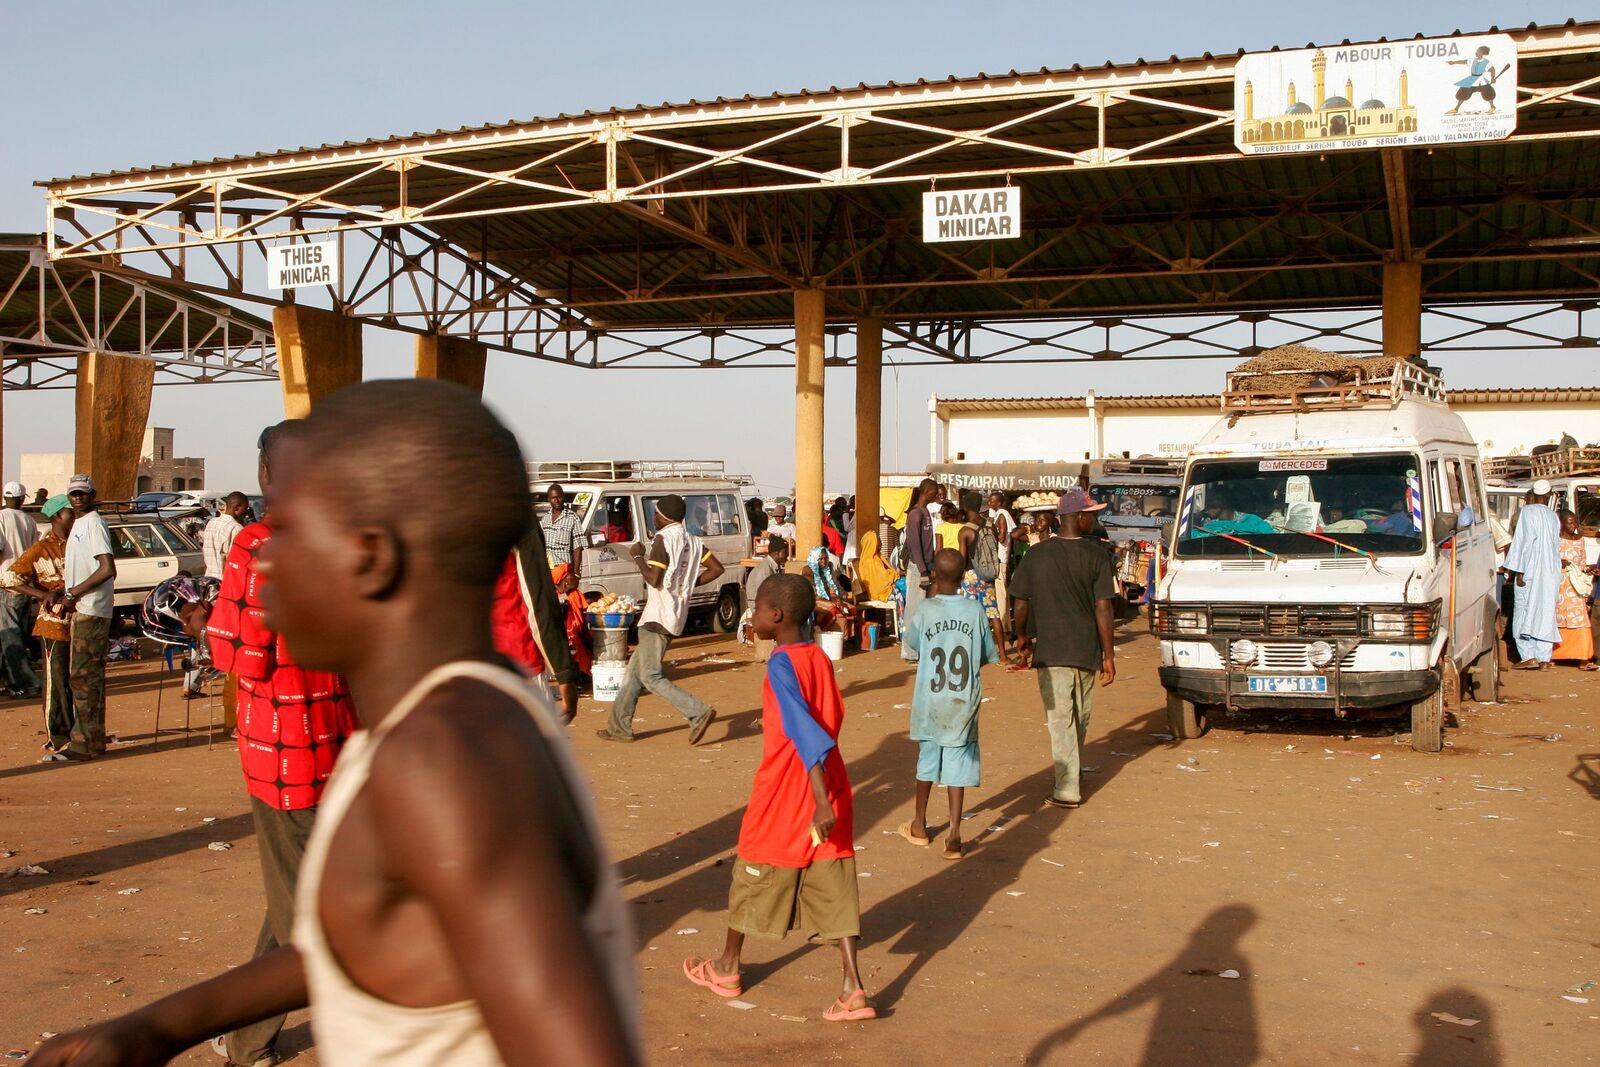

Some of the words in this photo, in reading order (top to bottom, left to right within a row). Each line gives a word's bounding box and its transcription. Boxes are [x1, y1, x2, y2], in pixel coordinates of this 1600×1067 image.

[1335, 47, 1392, 63] MBOUR
[1405, 42, 1459, 59] TOUBA
[1342, 139, 1368, 147] TOUBA
[1413, 134, 1440, 143] SALIOU
[935, 191, 1008, 217] DAKAR
[939, 216, 1012, 238] MINICAR
[280, 245, 322, 267] THIES
[280, 265, 330, 286] MINICAR
[1272, 460, 1326, 470] MERCEDES
[940, 473, 1016, 489] RESTAURANT
[1039, 475, 1079, 489] KHADY
[930, 645, 970, 694] 39
